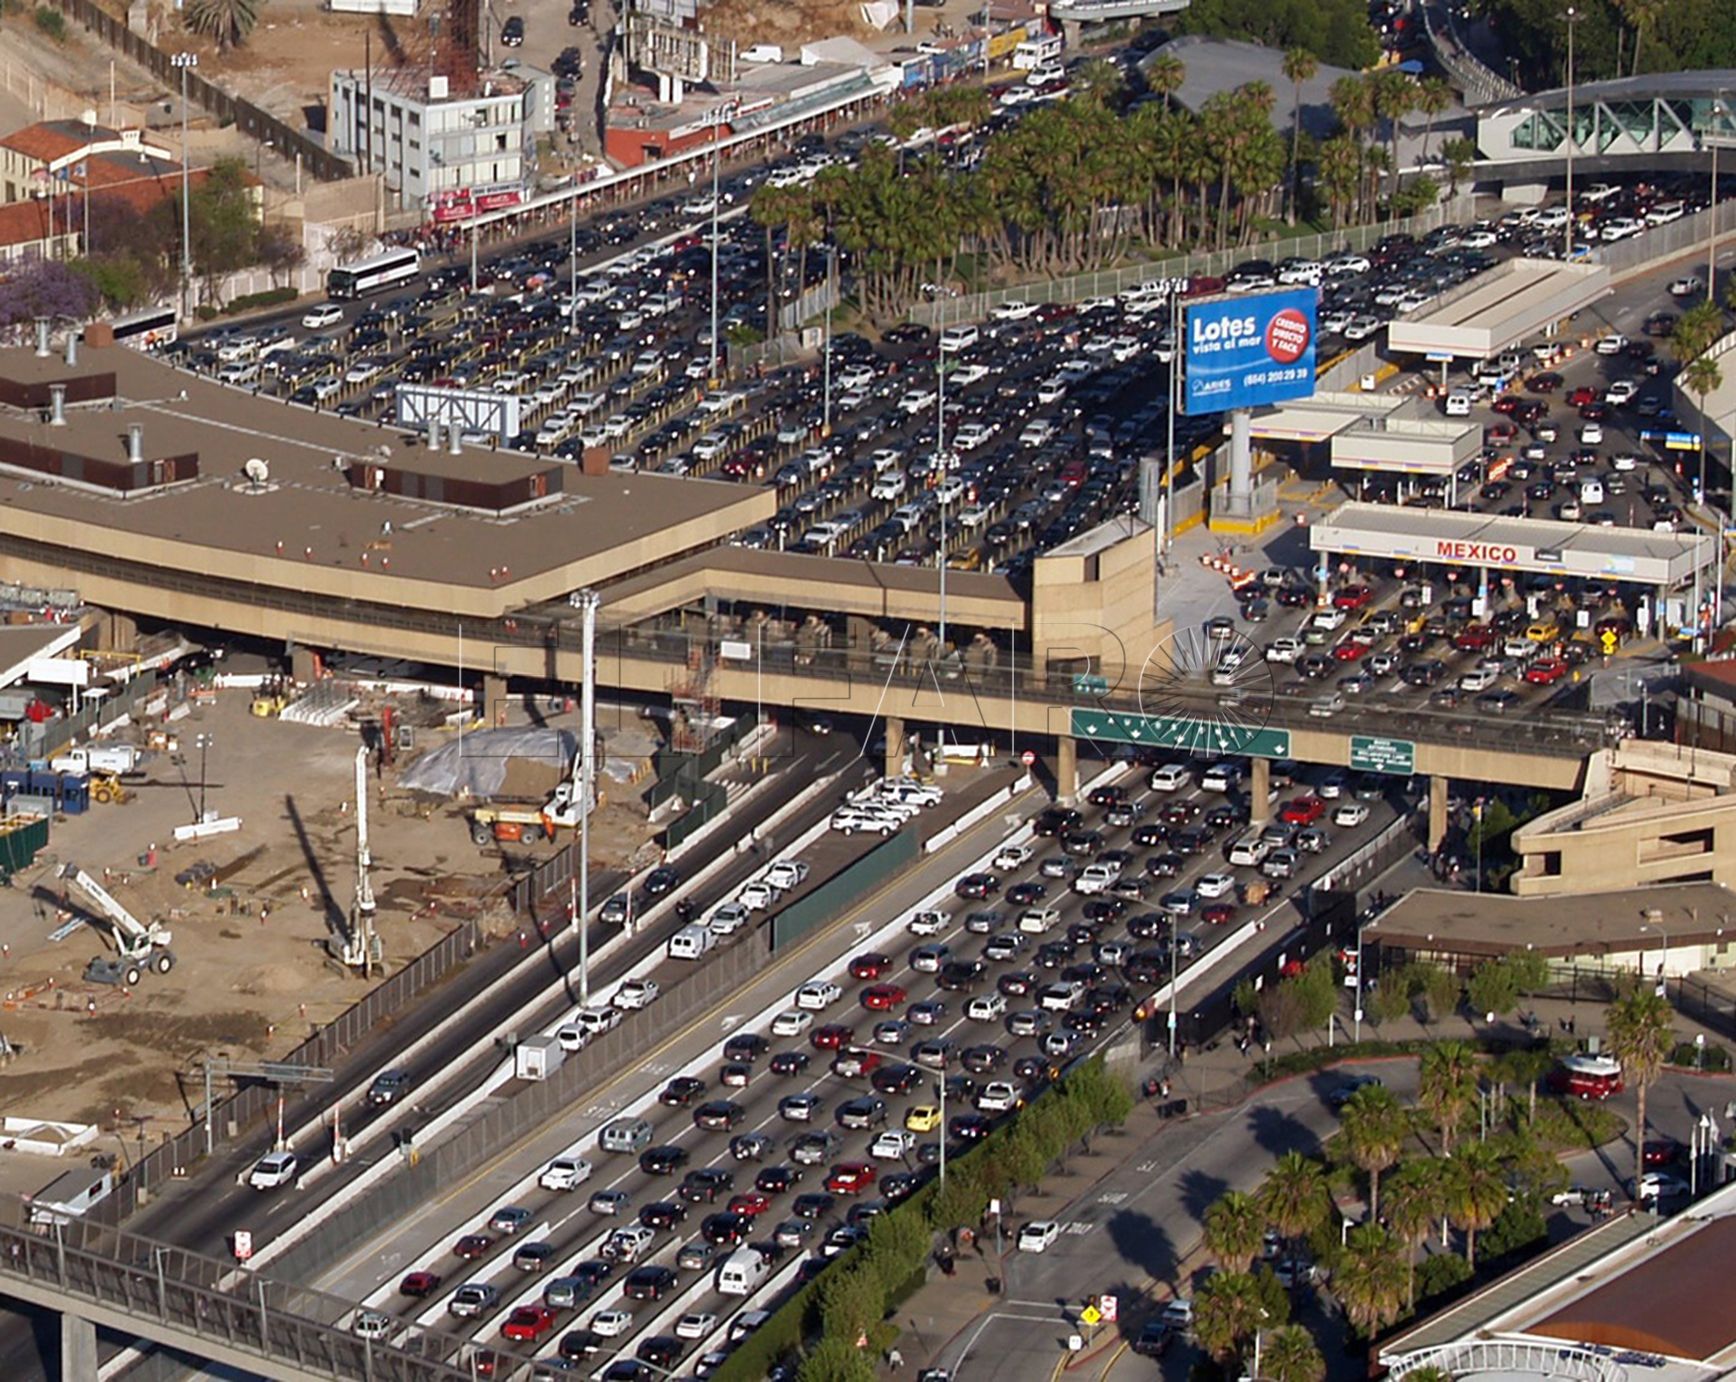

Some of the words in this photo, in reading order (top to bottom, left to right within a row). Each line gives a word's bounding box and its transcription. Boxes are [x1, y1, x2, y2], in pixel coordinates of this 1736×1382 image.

[1193, 316, 1256, 343] Lotes
[1193, 342, 1221, 354] vista
[1224, 337, 1235, 350] al
[1238, 336, 1261, 348] mar
[1437, 541, 1516, 562] MEXICO
